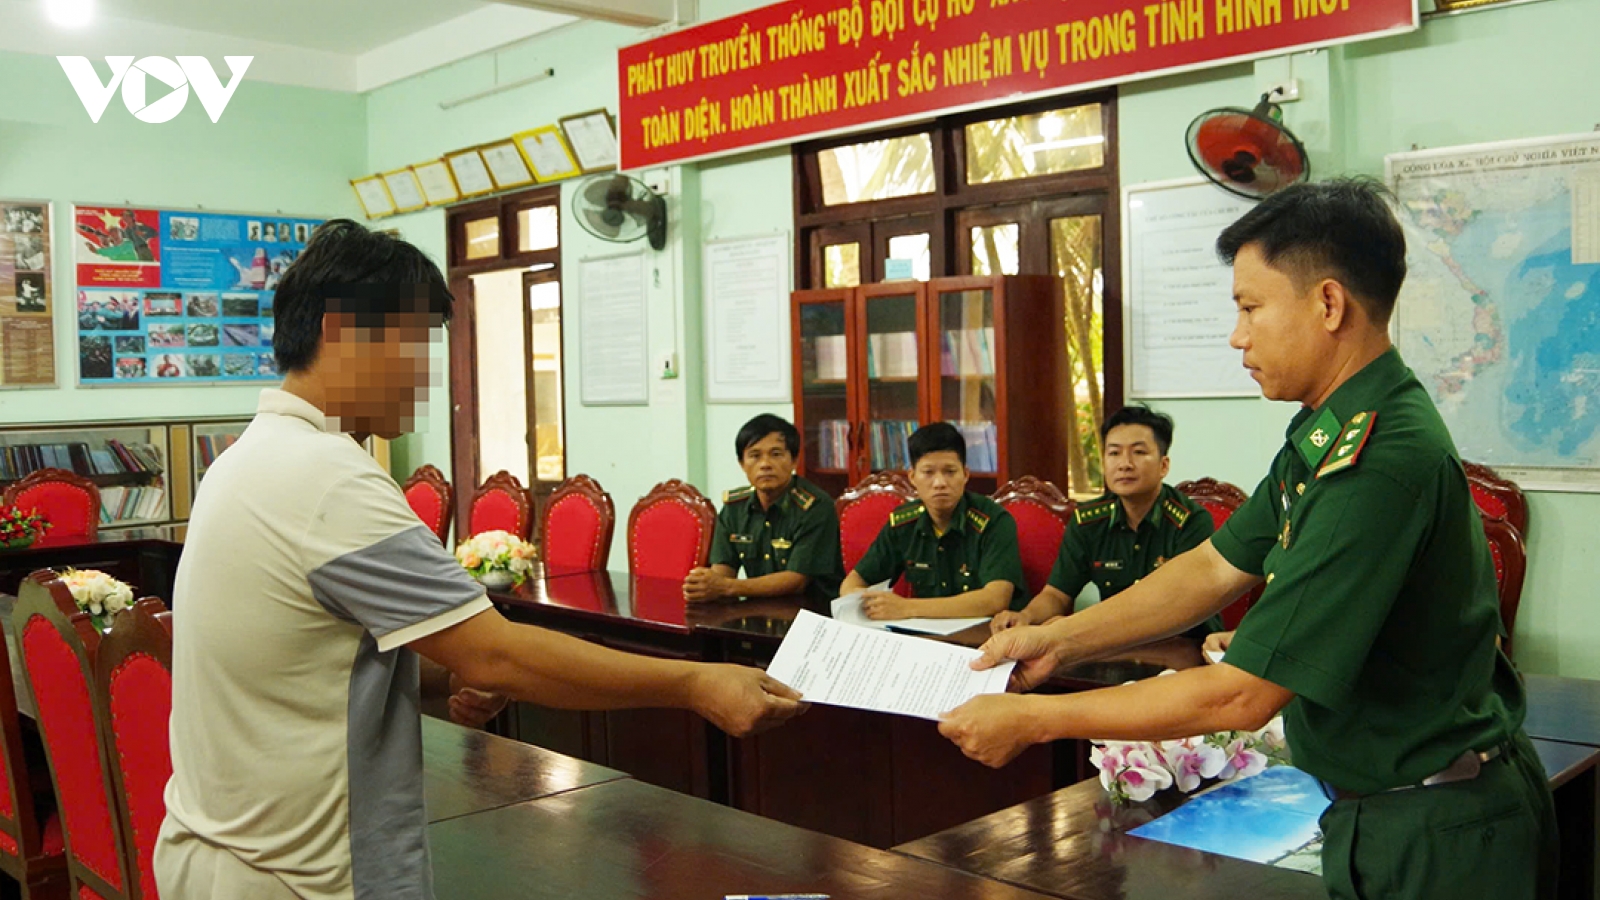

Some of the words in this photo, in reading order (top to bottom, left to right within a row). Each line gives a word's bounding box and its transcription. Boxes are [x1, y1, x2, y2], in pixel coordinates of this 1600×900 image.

[627, 52, 663, 97] PHÁT
[666, 48, 696, 87] HUY
[698, 23, 761, 78] TRUYỀN
[767, 10, 825, 61] THỐNG
[641, 103, 681, 149] TOÀN
[730, 85, 775, 131] HOÀN
[778, 74, 838, 121] THÀNH
[843, 51, 891, 109] XUẤT
[897, 40, 937, 97] SẮC
[944, 32, 1013, 89] NHIỆM
[1018, 28, 1049, 78] VỤ
[1055, 9, 1137, 65] TRONG
